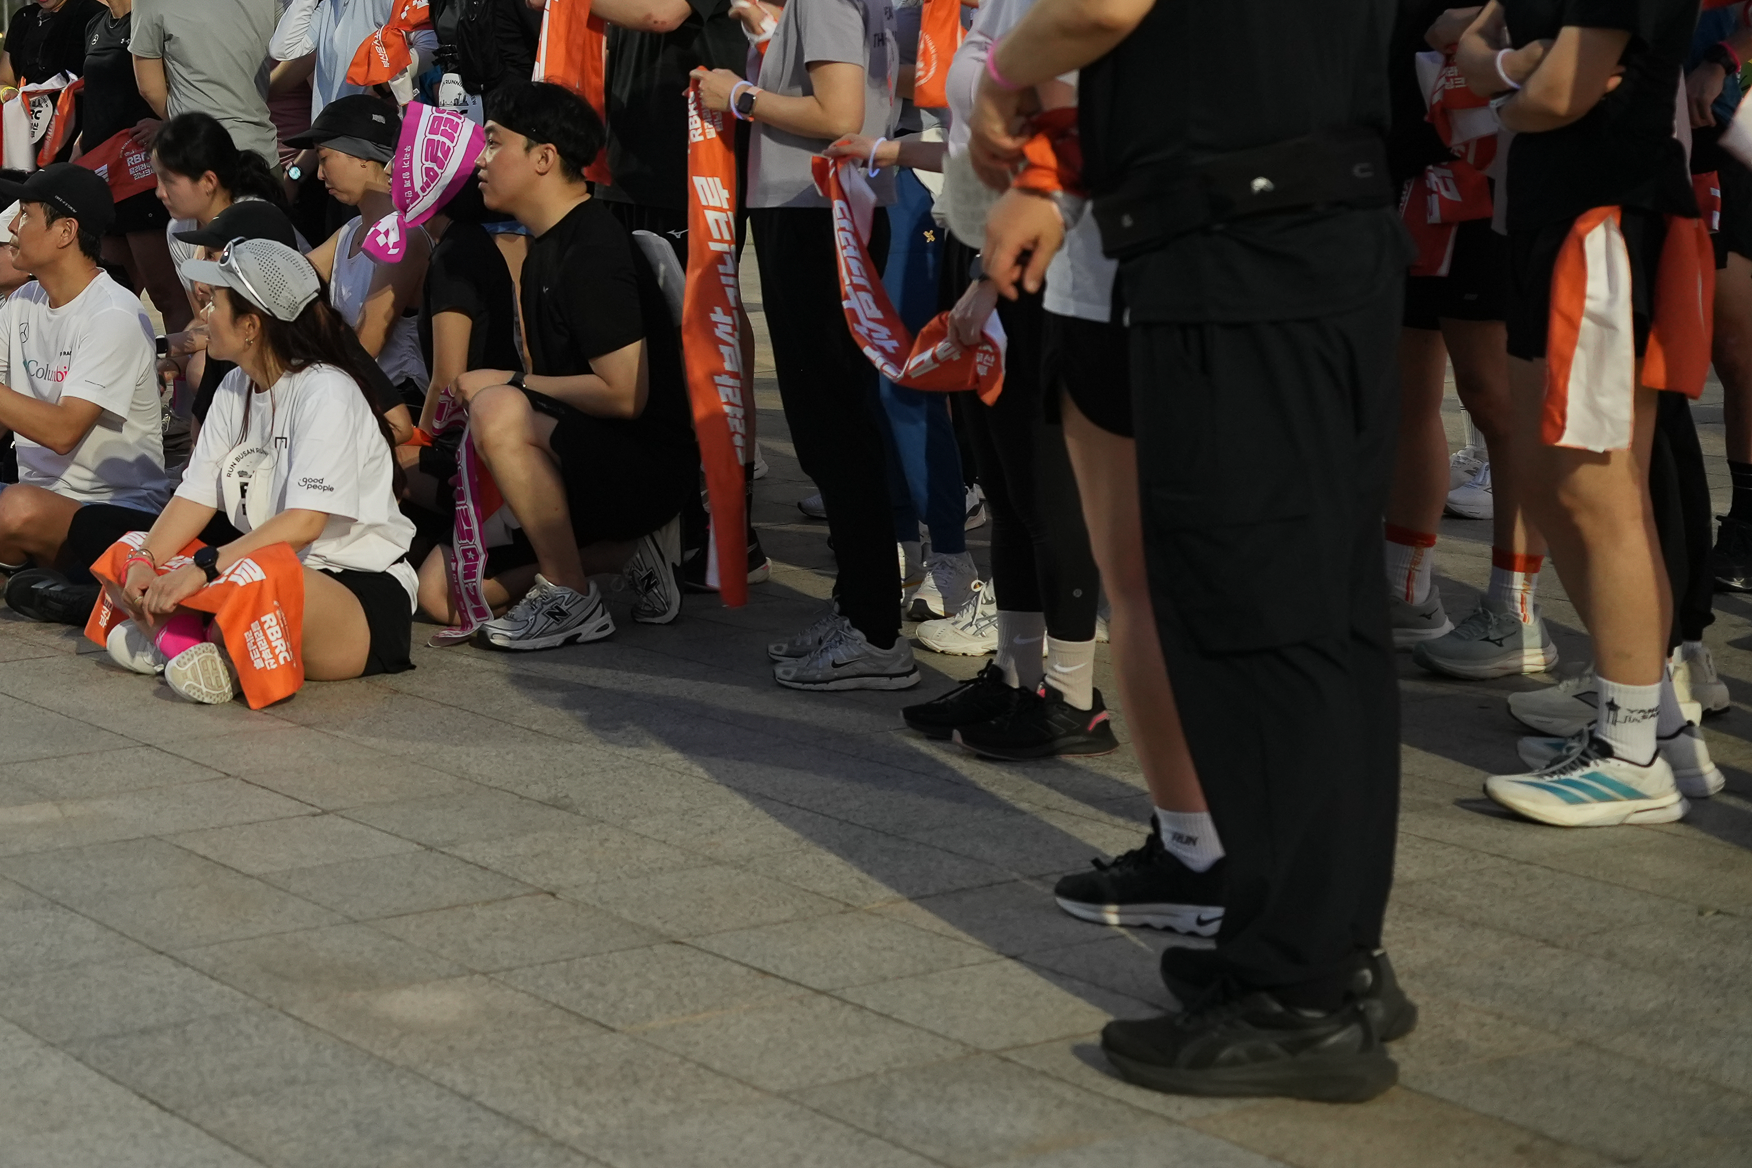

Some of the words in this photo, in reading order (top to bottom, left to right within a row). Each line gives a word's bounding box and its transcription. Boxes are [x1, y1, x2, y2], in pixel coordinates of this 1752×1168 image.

[226, 462, 237, 478] RUN
[235, 448, 255, 463] BUSAN
[298, 477, 324, 487] good
[306, 484, 335, 493] people
[244, 629, 265, 670] 러닝크루
[250, 620, 278, 670] 달려라부산
[260, 612, 291, 666] RBRC
